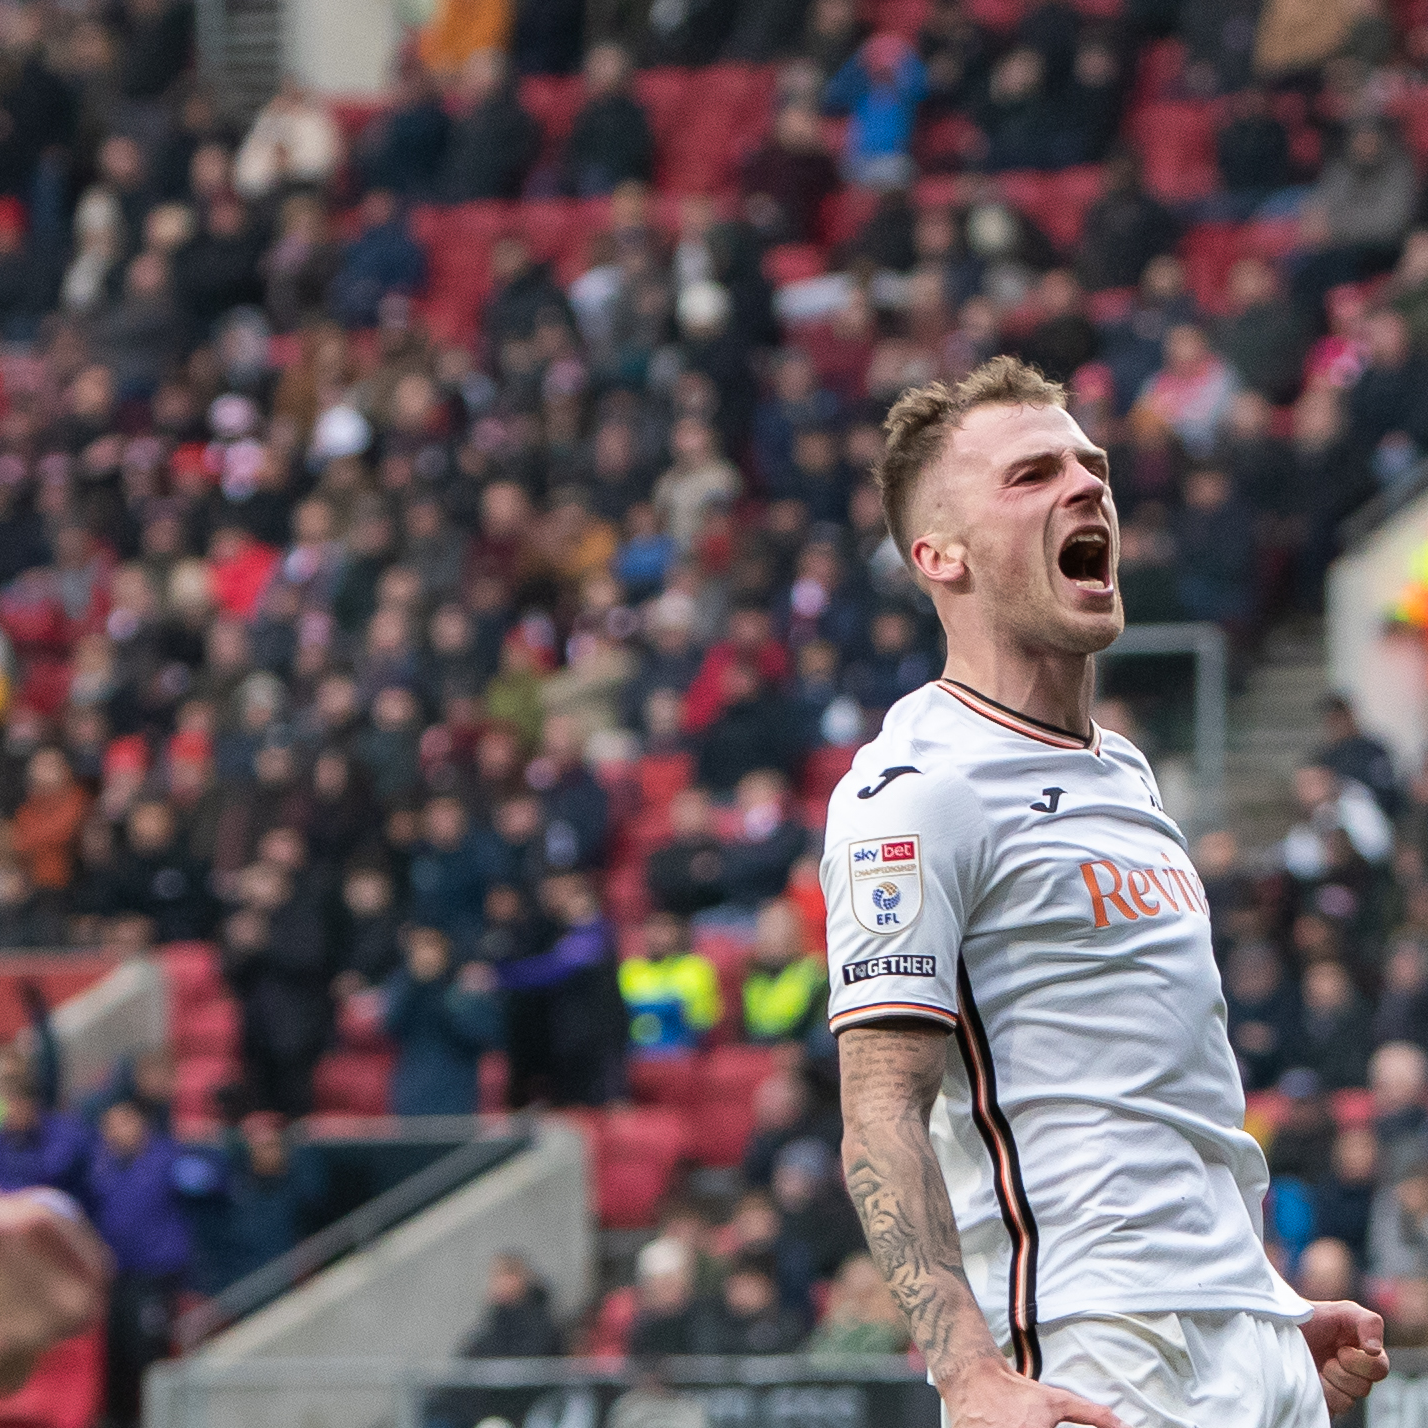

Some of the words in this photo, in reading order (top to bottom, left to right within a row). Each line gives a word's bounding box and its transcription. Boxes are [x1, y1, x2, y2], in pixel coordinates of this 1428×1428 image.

[853, 848, 878, 863] sky
[883, 843, 912, 859] bet
[876, 912, 900, 926] EFL
